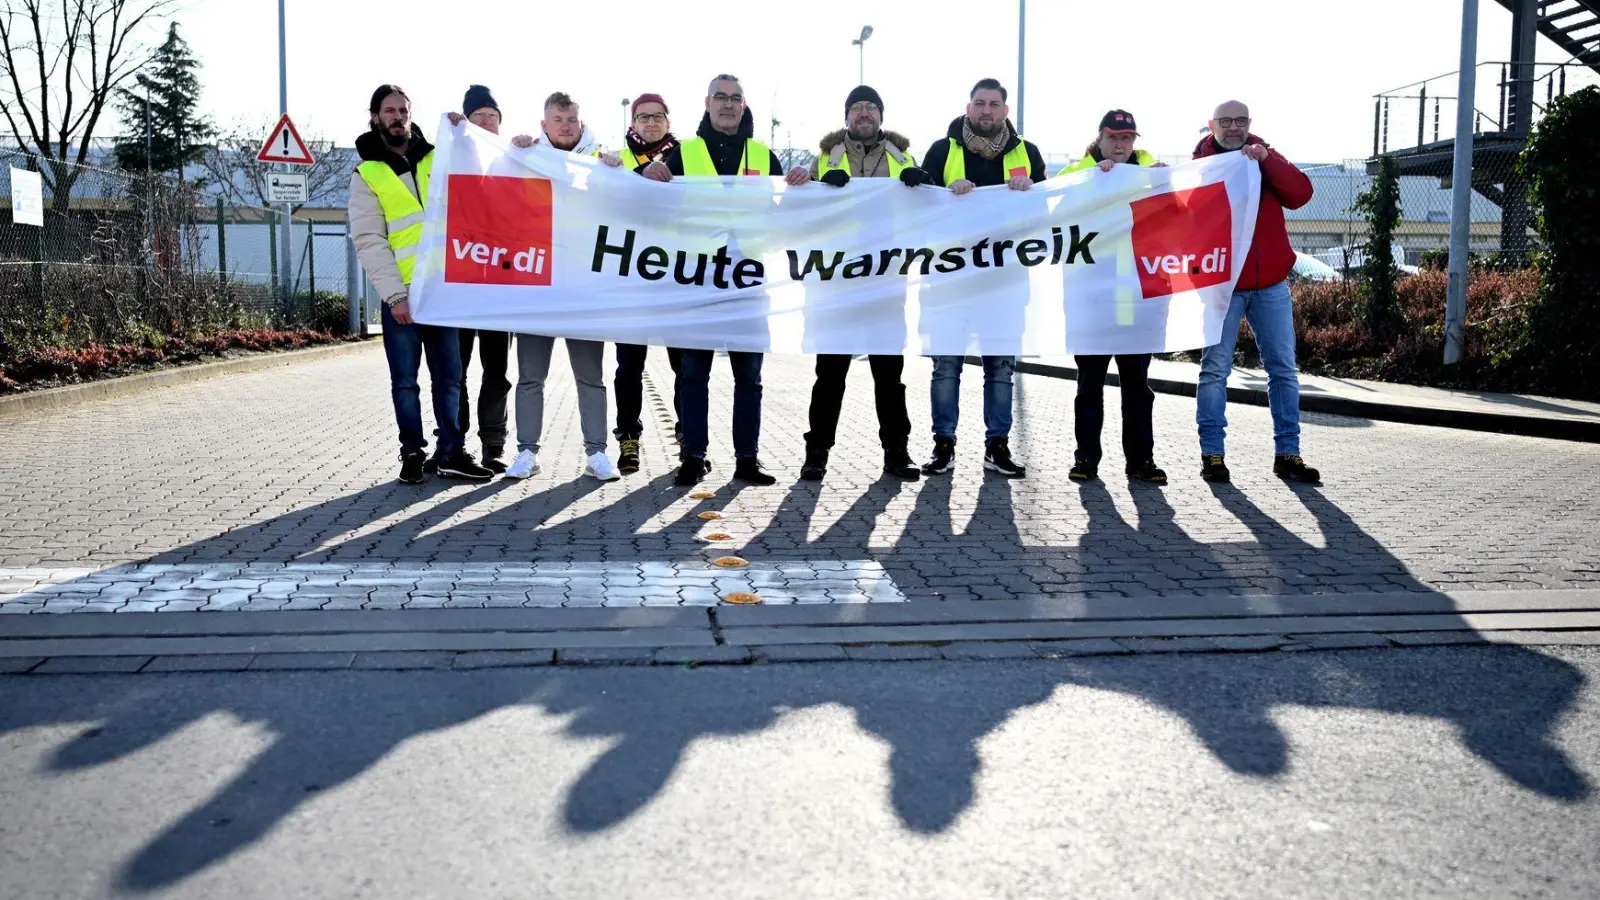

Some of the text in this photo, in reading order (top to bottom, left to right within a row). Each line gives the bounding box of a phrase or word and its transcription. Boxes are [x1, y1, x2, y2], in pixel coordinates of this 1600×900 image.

[452, 238, 546, 275] ver.di
[592, 225, 1099, 290] Heute Warnstreik
[1140, 247, 1227, 276] ver.di
